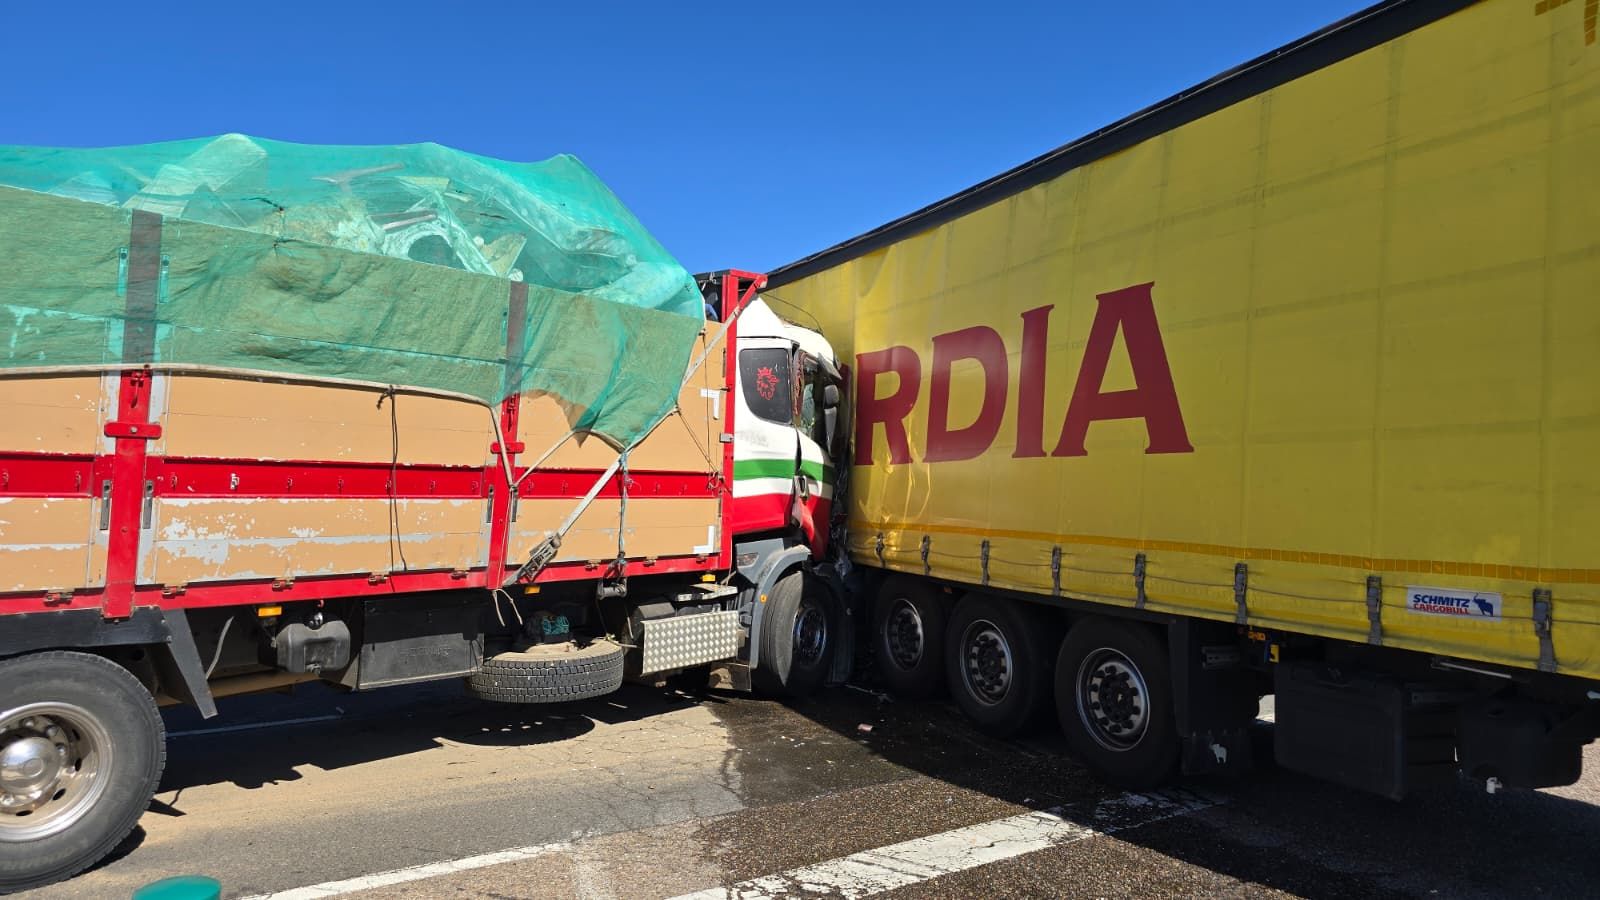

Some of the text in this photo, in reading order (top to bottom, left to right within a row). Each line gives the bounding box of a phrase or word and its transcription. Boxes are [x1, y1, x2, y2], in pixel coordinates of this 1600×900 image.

[840, 281, 1195, 466] RDIA
[1412, 593, 1471, 608] SCHMITZ
[1413, 602, 1471, 615] CARGOBULL
